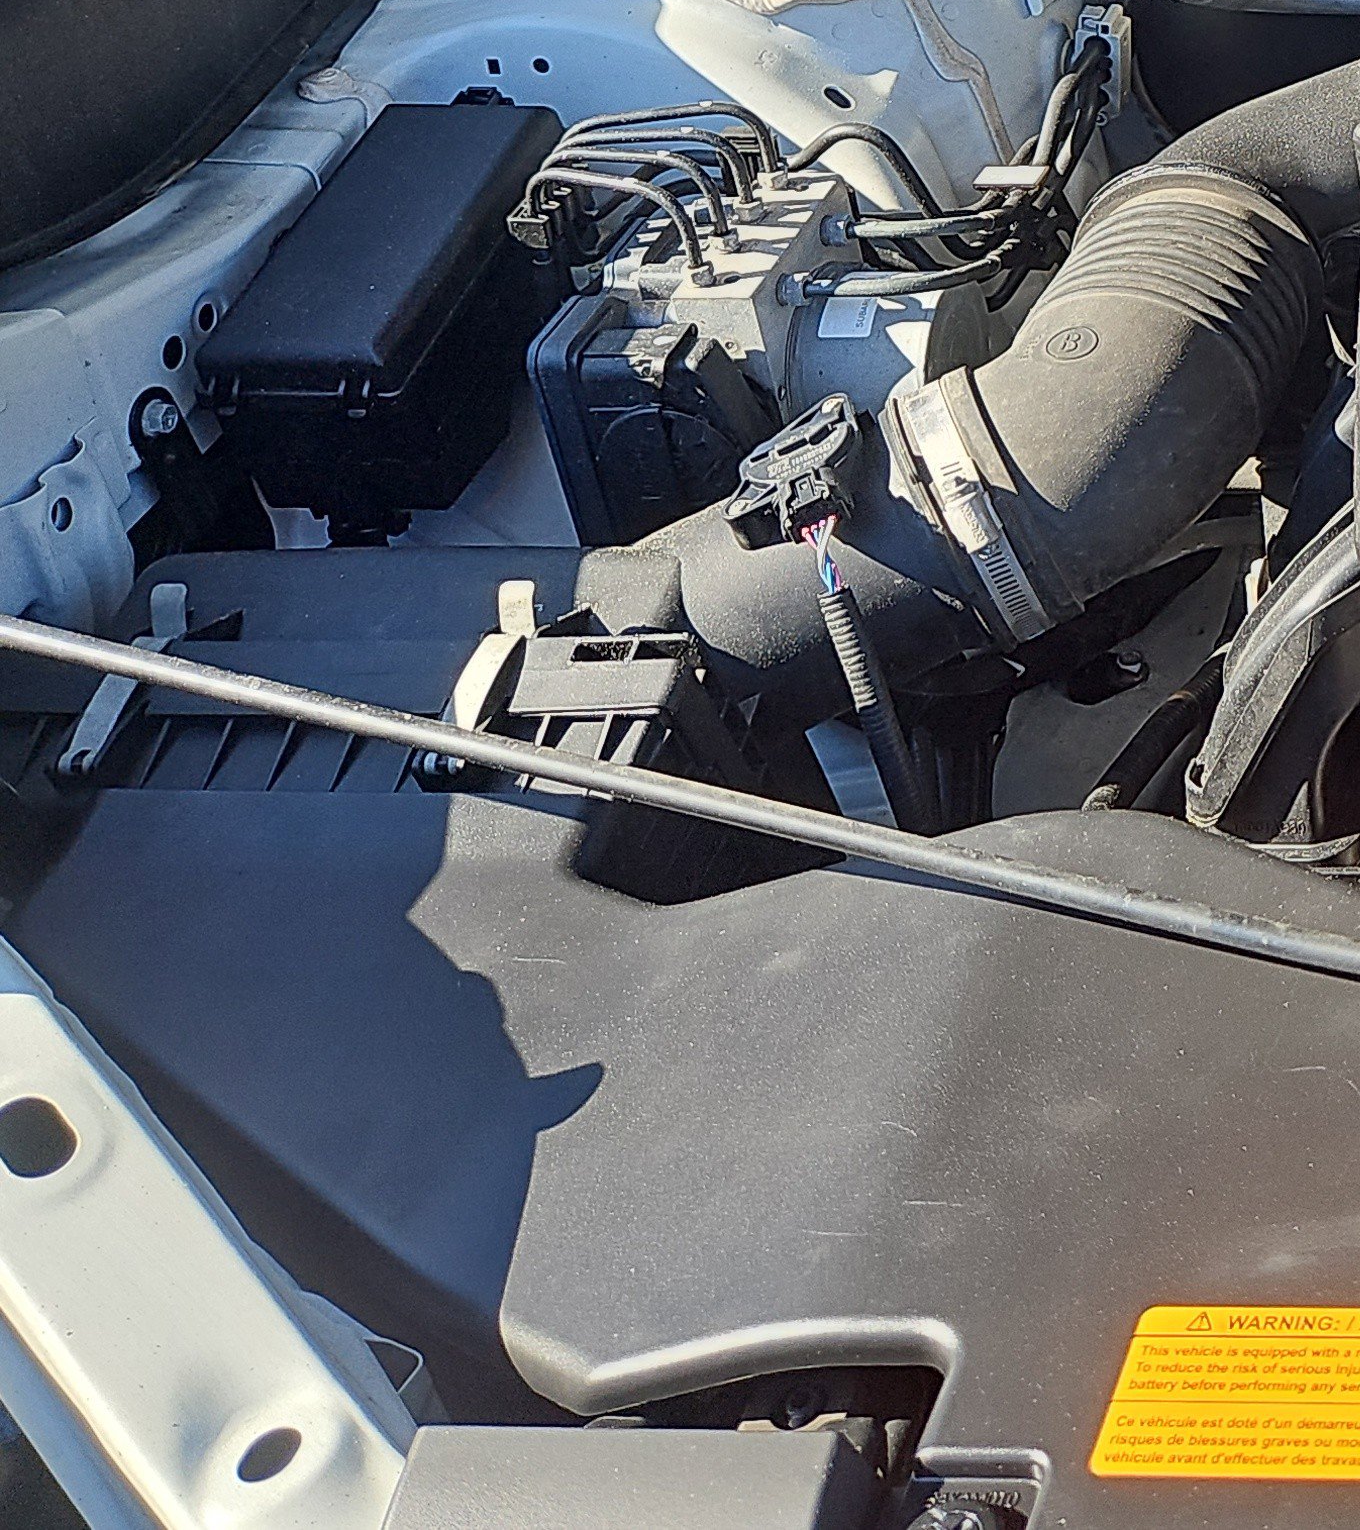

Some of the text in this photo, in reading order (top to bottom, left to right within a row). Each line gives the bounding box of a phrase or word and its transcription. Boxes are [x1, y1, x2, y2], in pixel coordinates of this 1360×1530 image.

[1226, 1315, 1341, 1330] WARNING:
[1140, 1344, 1170, 1355] This
[1173, 1347, 1223, 1356] vehicle
[1226, 1348, 1239, 1356] is
[1241, 1348, 1307, 1358] equipped
[1311, 1348, 1339, 1357] with
[1343, 1349, 1352, 1357] a
[1135, 1361, 1153, 1372] To
[1154, 1364, 1203, 1372] reduce
[1206, 1363, 1229, 1373] the
[1232, 1365, 1258, 1373] risk
[1261, 1362, 1278, 1373] of
[1279, 1365, 1331, 1374] serious
[1128, 1379, 1178, 1390] battery
[1181, 1380, 1226, 1390] before
[1229, 1381, 1307, 1392] performing
[1310, 1383, 1336, 1393] any
